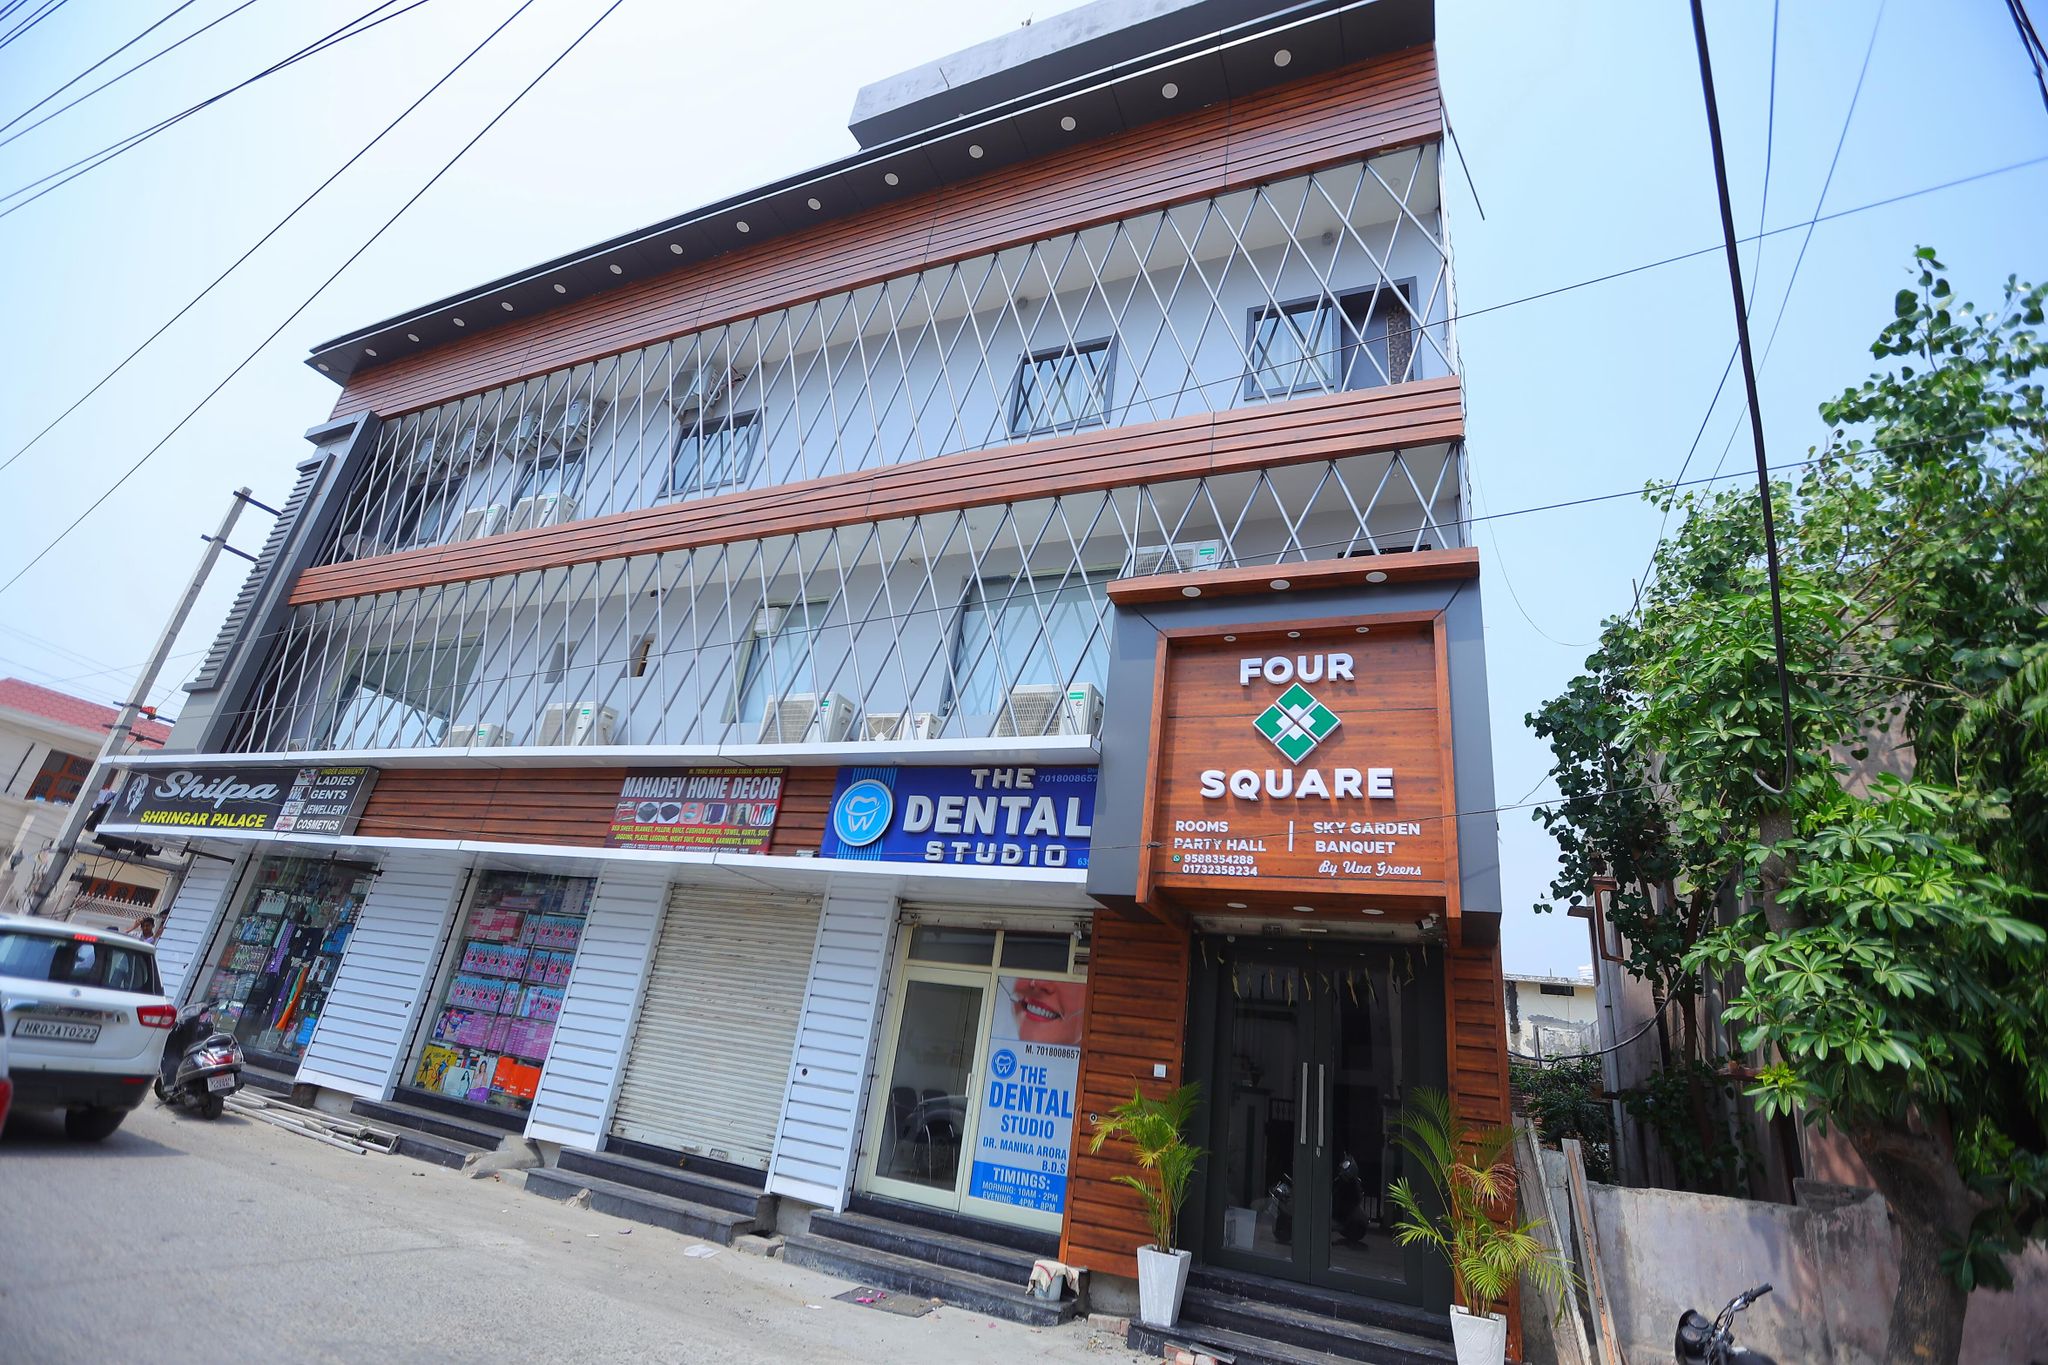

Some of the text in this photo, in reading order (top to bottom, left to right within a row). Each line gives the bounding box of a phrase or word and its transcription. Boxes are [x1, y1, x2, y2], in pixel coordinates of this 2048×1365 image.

[1239, 652, 1355, 687] FOUR
[315, 775, 357, 786] LADIES
[620, 776, 782, 800] MAHADEV HOME DECOR
[971, 768, 1037, 790] THE
[1200, 767, 1395, 801] SQUARE
[154, 770, 280, 810] Shilpa
[310, 789, 348, 800] GENTS
[140, 810, 268, 828] SHRINGAR PALACE
[303, 804, 349, 816] JEWELLERY
[903, 794, 1092, 838] DENTAL
[296, 819, 340, 831] COSMETICS
[1175, 820, 1229, 833] ROOMS
[1313, 821, 1421, 836] SKY GARDEN
[924, 840, 1068, 867] STUDIO
[1173, 837, 1267, 852] PARTY HALL
[1315, 840, 1396, 854] BANQUET
[1184, 853, 1254, 865] 9588354288
[1182, 864, 1258, 876] 01732358234
[1318, 860, 1338, 877] By
[1375, 861, 1422, 877] Greens
[1025, 1044, 1080, 1060] M. 7018008657
[1019, 1065, 1048, 1086] THE
[988, 1081, 1073, 1119] DENTAL
[1000, 1114, 1055, 1140] STUDIO
[983, 1136, 1067, 1161] DR. MANIKA ARORA
[1041, 1160, 1066, 1175] B.D.S
[993, 1167, 1051, 1191] TIMINGS:
[982, 1181, 1016, 1195] MORNING:
[1018, 1188, 1037, 1199] 10AM
[1043, 1193, 1059, 1203] 2PM
[982, 1191, 1014, 1205] EVENING:
[1018, 1198, 1034, 1209] 4PM
